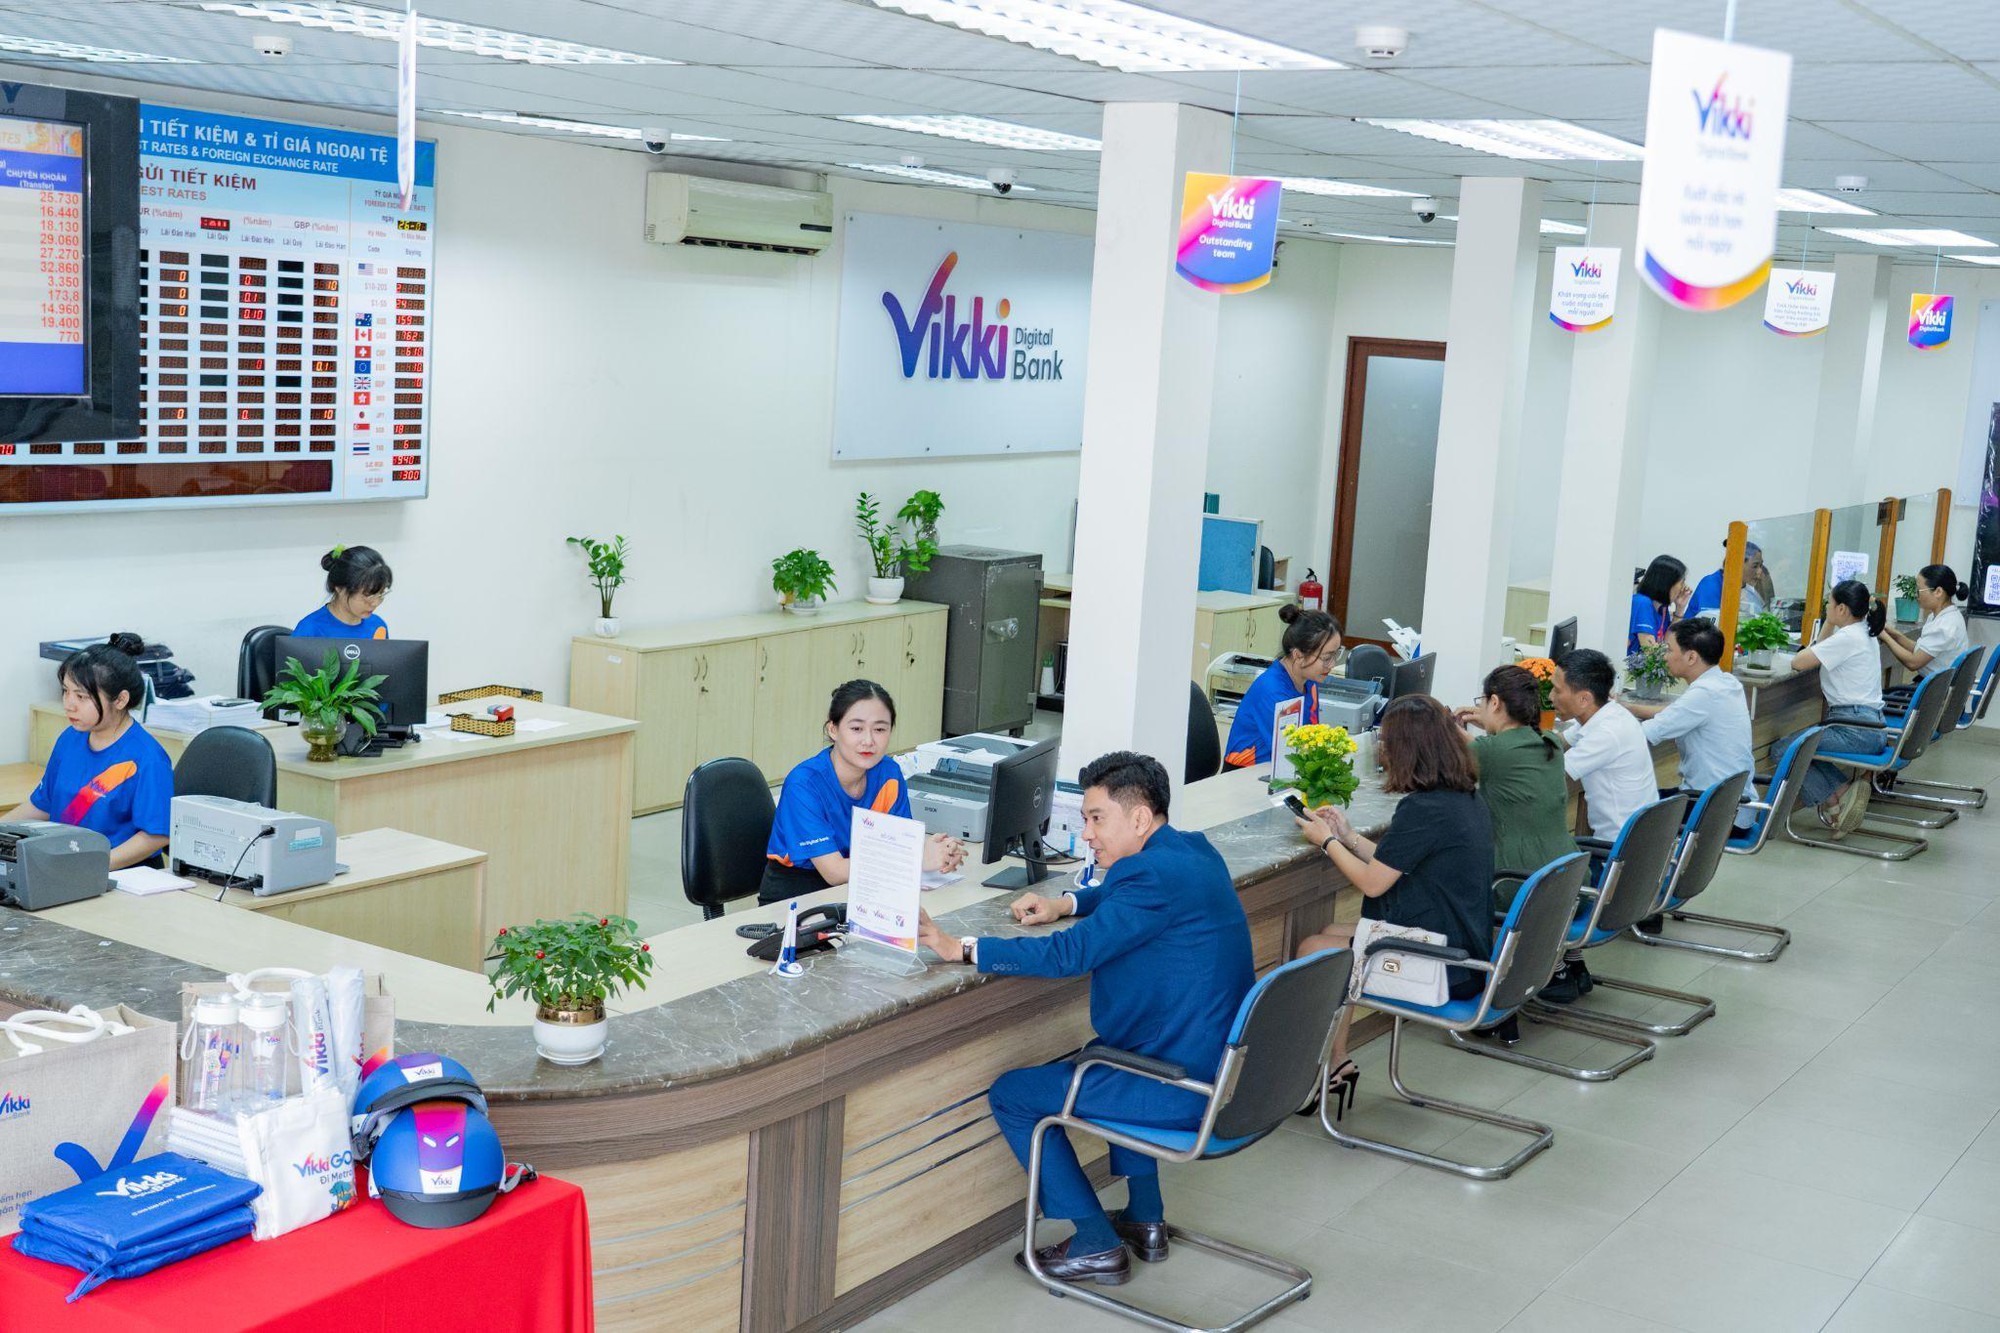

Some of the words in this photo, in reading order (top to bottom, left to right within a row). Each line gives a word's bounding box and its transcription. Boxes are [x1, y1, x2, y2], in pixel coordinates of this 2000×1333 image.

[1692, 70, 1756, 140] Vikki
[150, 118, 189, 138] TIẾT
[195, 125, 238, 145] KIỆM
[245, 133, 256, 147] &
[284, 137, 311, 153] GIÁ
[317, 141, 365, 161] NGOẠI
[370, 146, 388, 165] TỆ
[152, 142, 188, 155] RATES
[191, 147, 199, 157] &
[202, 148, 250, 162] FOREIGN
[254, 154, 310, 169] EXCHANGE
[313, 161, 339, 173] RATE
[170, 167, 207, 185] TIẾT
[214, 173, 256, 191] KIỆM
[40, 191, 79, 205] 25.730
[168, 188, 206, 200] RATES
[1207, 187, 1255, 220] Vikki
[40, 206, 79, 219] 16.440
[40, 220, 79, 233] 18.130
[294, 221, 310, 229] GBP
[40, 234, 79, 247] 29.060
[1199, 235, 1253, 251] Outstanding
[40, 248, 79, 260] 27.270
[1213, 249, 1236, 259] team
[40, 261, 79, 273] 32.860
[1571, 256, 1602, 278] Vikki
[48, 276, 79, 288] 3.350
[1786, 277, 1817, 296] Vikki
[41, 303, 80, 315] 14.960
[882, 251, 1010, 379] Vikki
[1916, 304, 1947, 326] Vikki
[41, 316, 80, 329] 19.400
[59, 331, 80, 342] 770
[1015, 326, 1053, 349] Digital
[1013, 350, 1063, 380] Bank
[303, 1032, 329, 1078] Vikki
[96, 1171, 178, 1197] Vikki
[432, 1174, 453, 1187] Vikki
